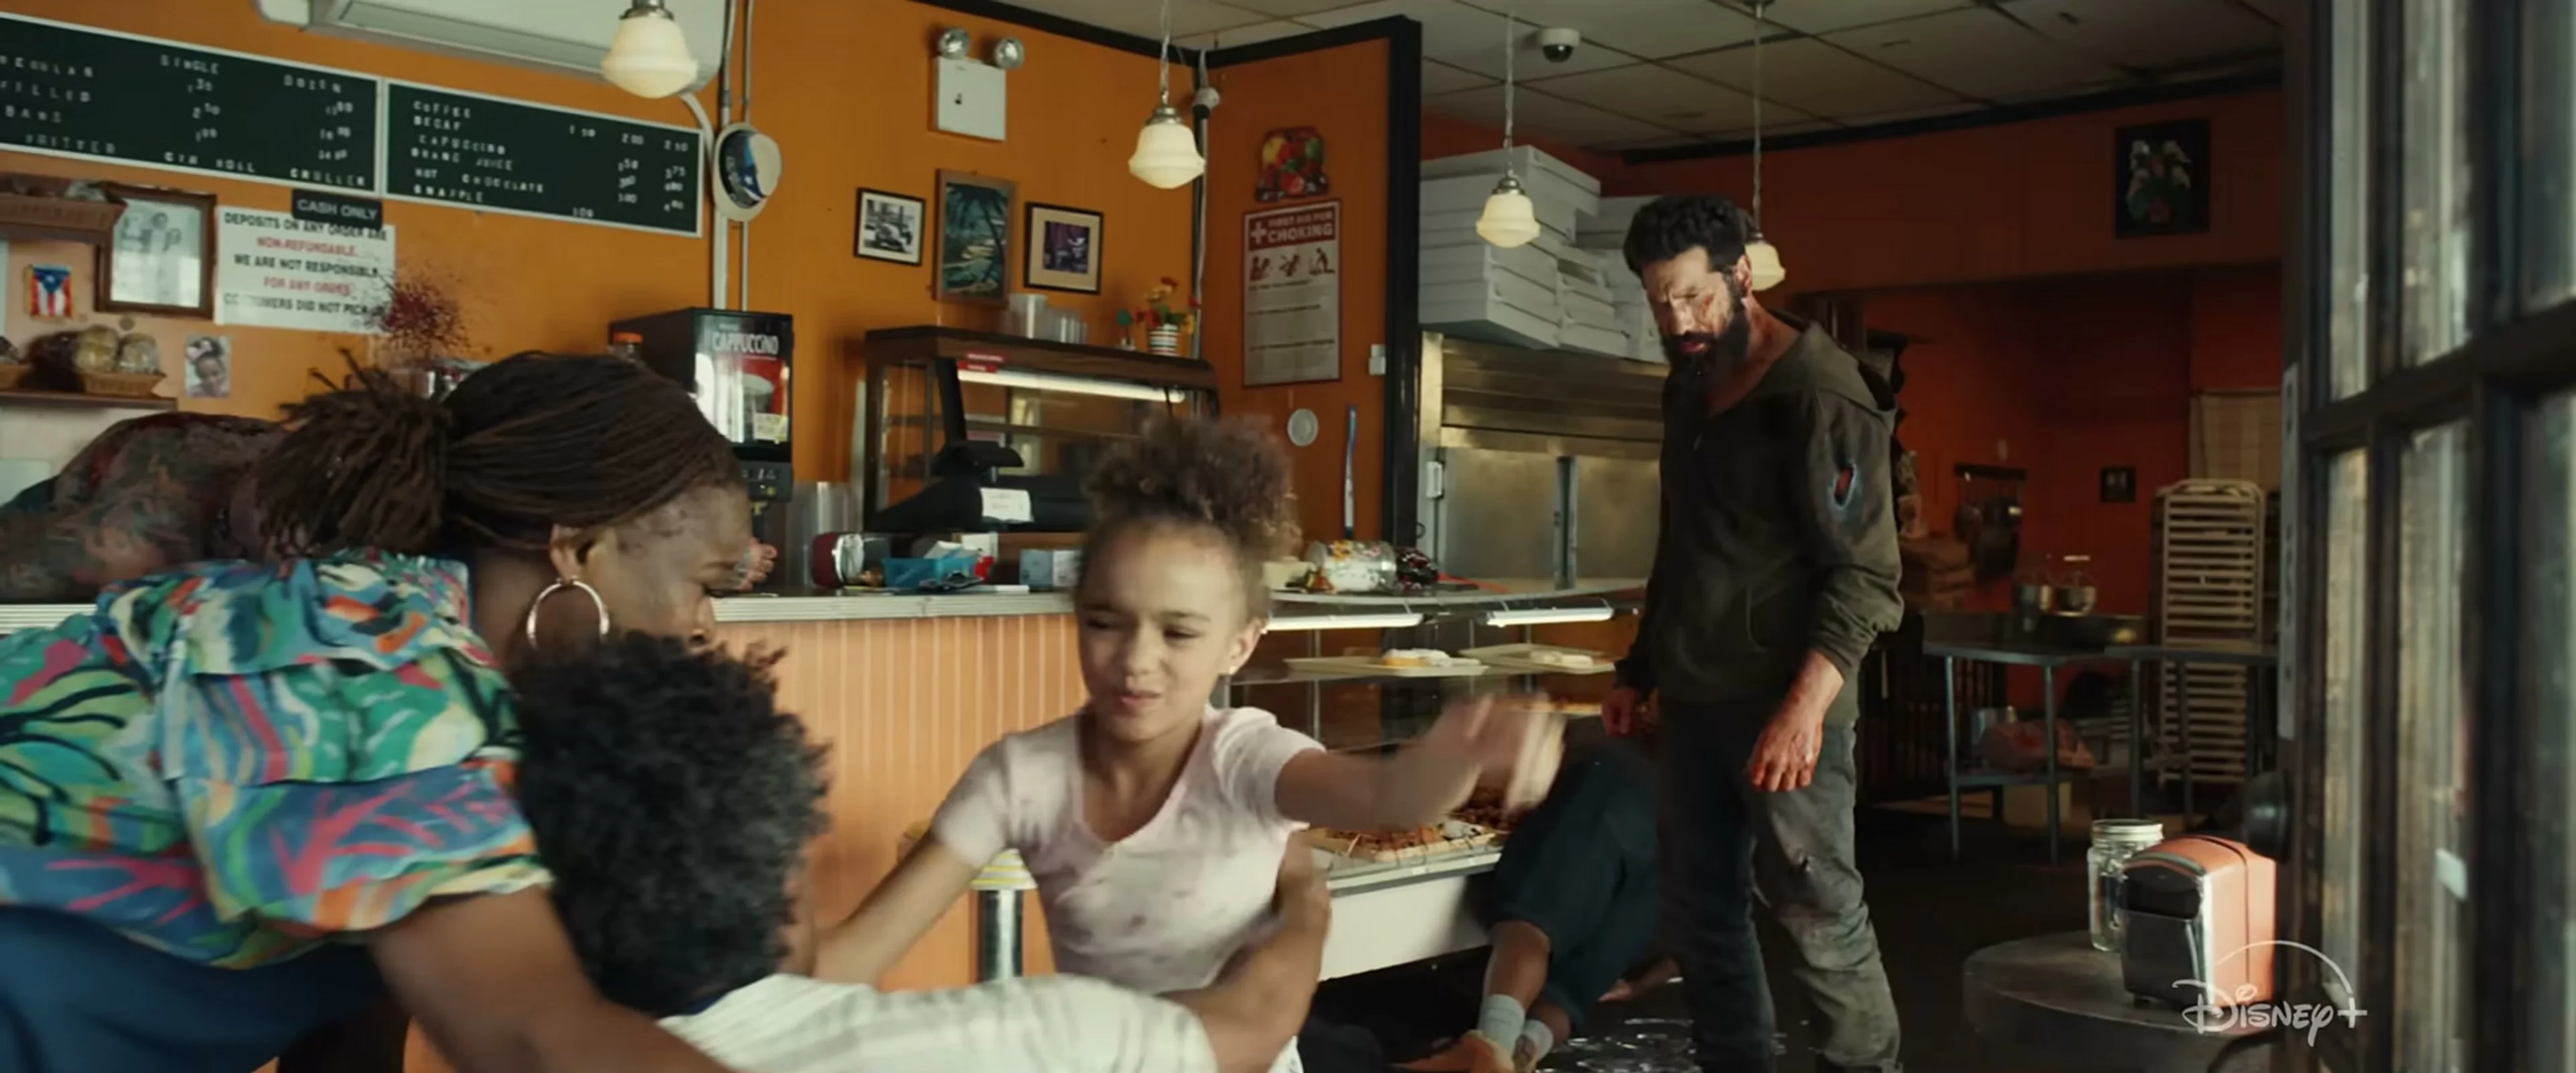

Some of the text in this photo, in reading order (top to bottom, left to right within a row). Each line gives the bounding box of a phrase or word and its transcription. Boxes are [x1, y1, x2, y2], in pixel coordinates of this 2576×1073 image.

[160, 54, 219, 74] SINGLE
[413, 101, 470, 119] COFFEE
[413, 115, 462, 131] DECAF
[297, 199, 378, 220] CASH ONLY
[225, 212, 280, 229] DEPOSITS
[284, 219, 299, 231] ON
[1267, 222, 1333, 243] CHOKING
[233, 253, 250, 266] WE
[254, 256, 276, 269] ARE
[279, 259, 303, 271] NOT
[264, 276, 285, 289] FOR
[296, 299, 315, 312] DID
[318, 301, 340, 314] NOT
